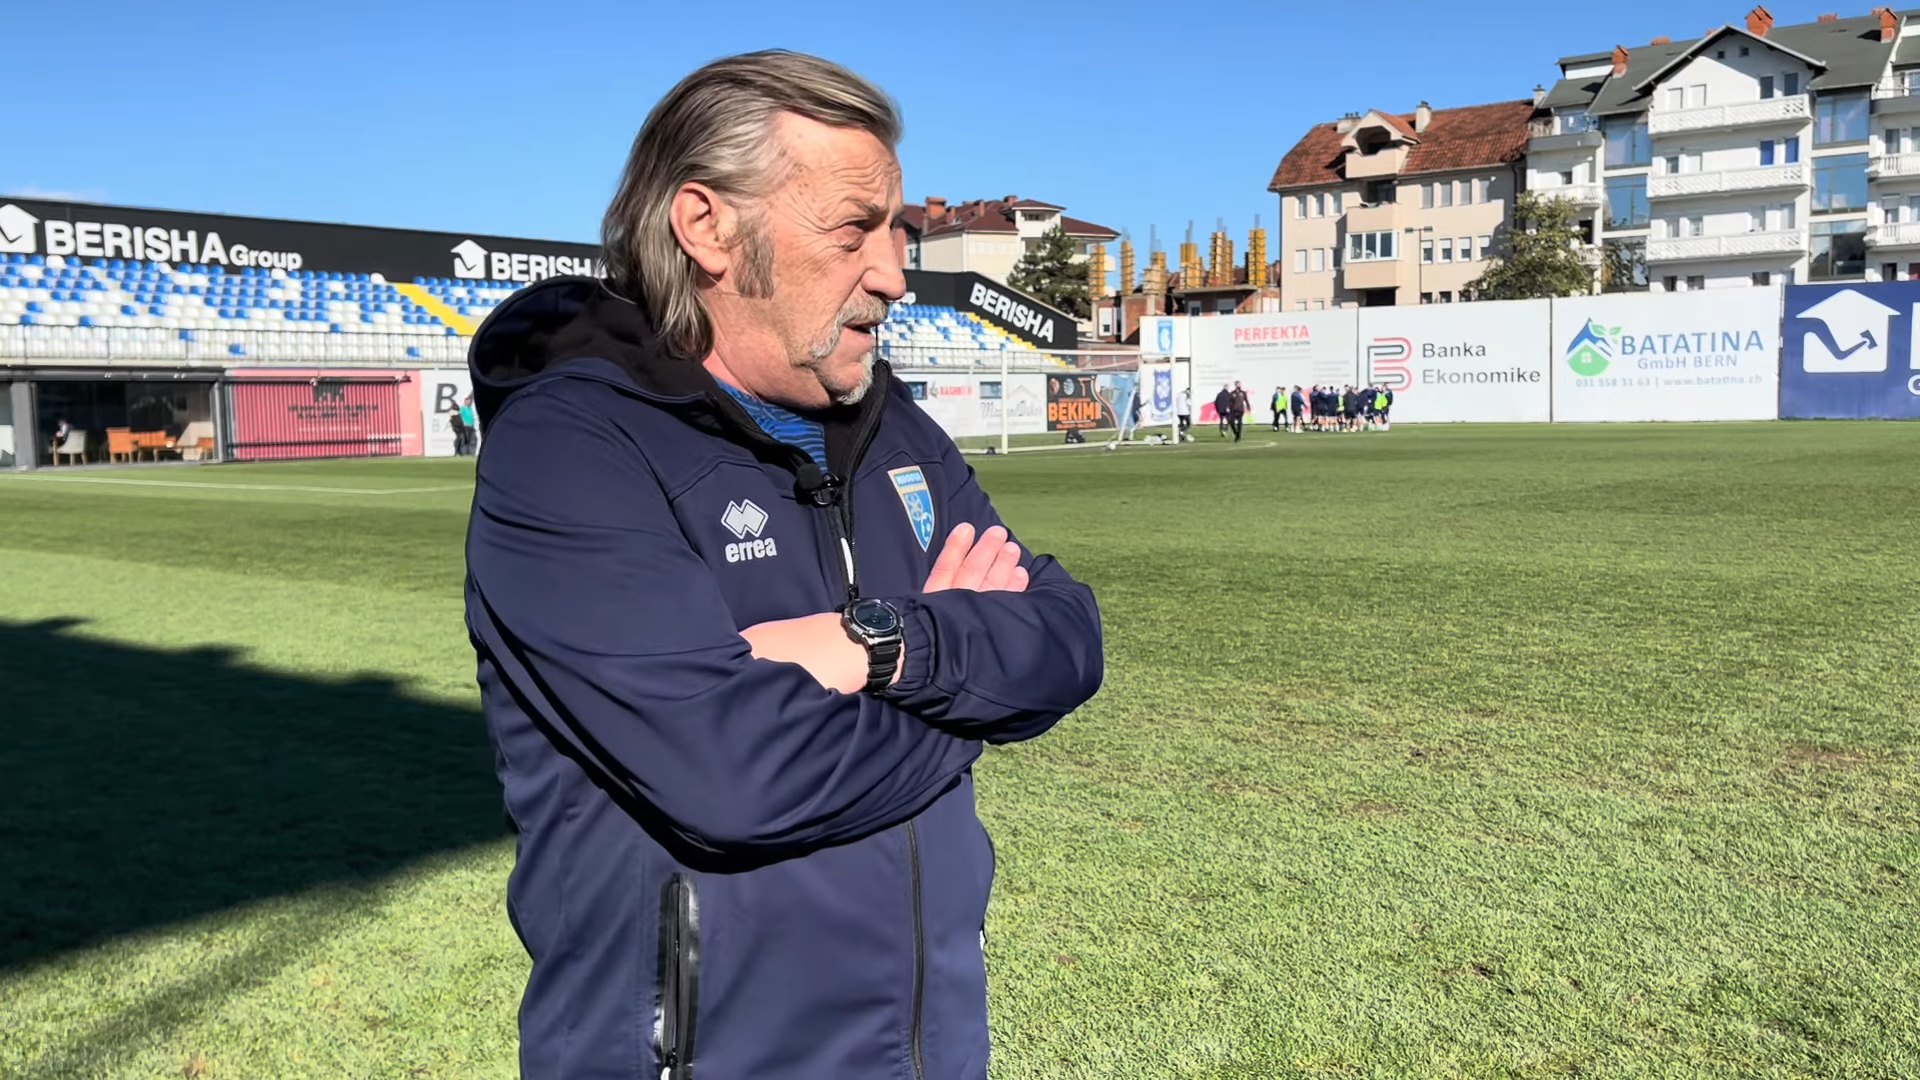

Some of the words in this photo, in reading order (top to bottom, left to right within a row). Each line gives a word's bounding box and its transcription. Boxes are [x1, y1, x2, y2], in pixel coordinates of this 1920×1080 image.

[44, 220, 228, 265] BERISHA
[230, 244, 303, 271] Group
[969, 282, 1054, 343] BERISHA
[1234, 325, 1310, 342] PERFEKTA
[1422, 342, 1486, 358] Banka
[1621, 330, 1765, 356] BATATINA
[1637, 356, 1687, 370] GmbH
[1693, 354, 1738, 368] BERN
[1422, 367, 1541, 384] Ekonomike
[1664, 373, 1763, 387] www.batatina.ch
[725, 537, 777, 562] errea
